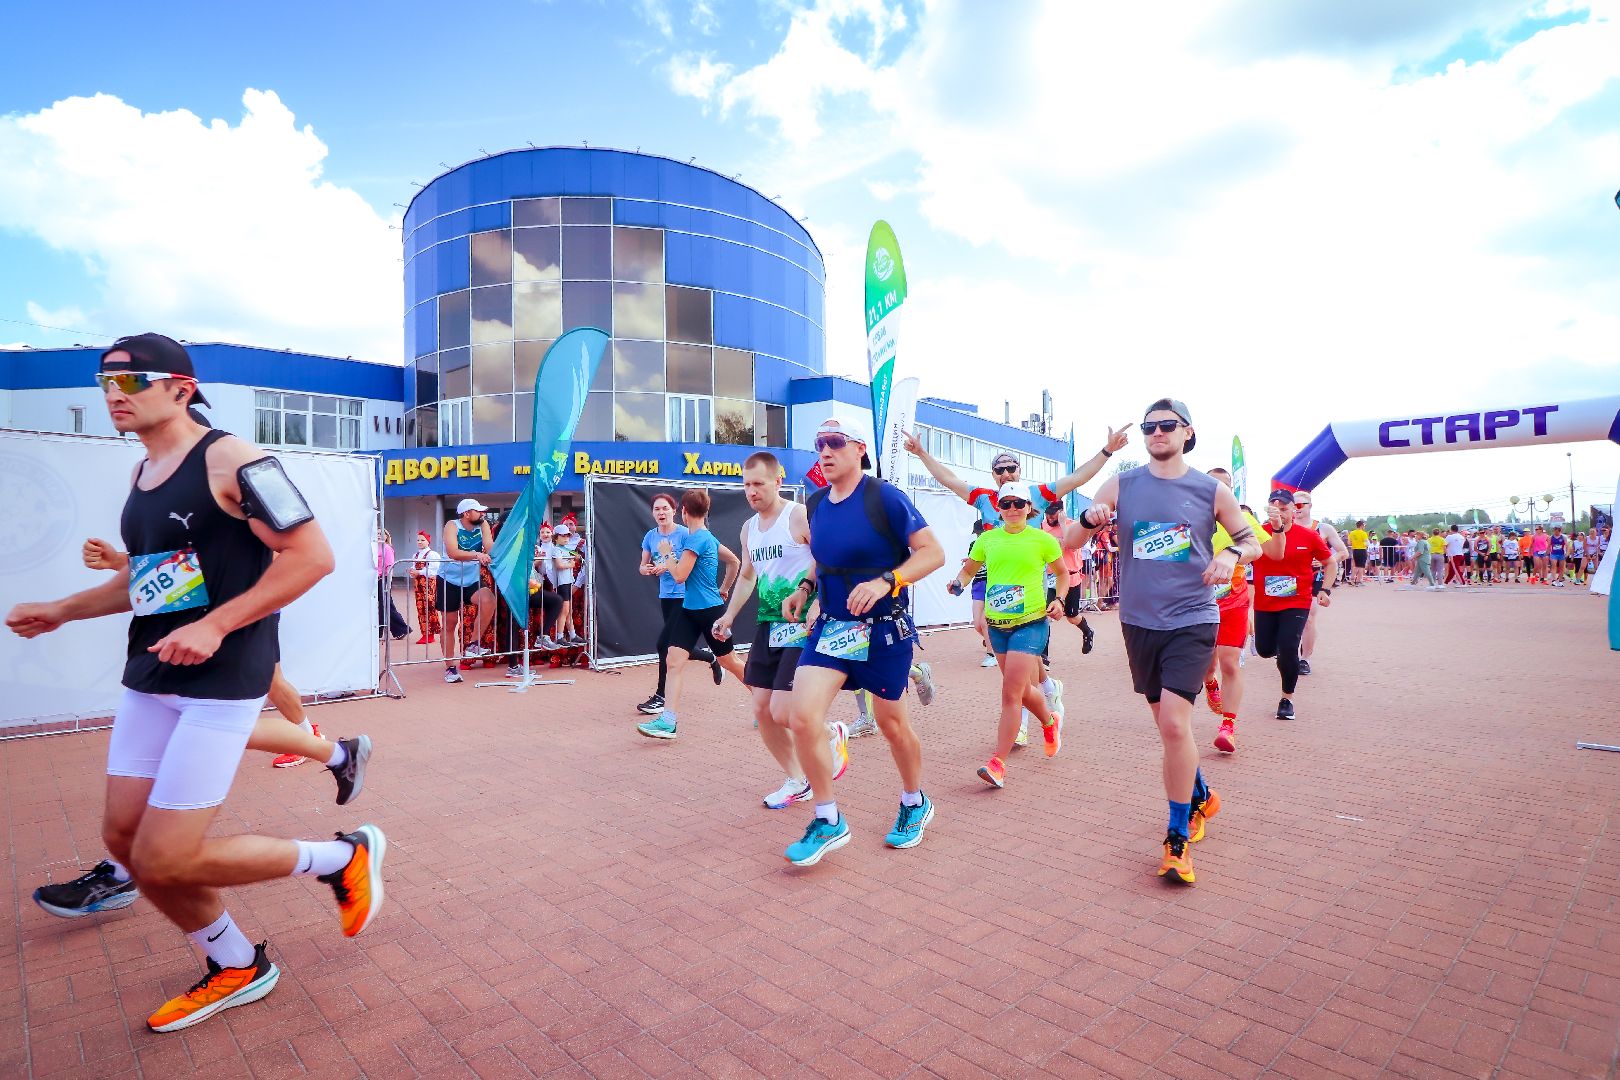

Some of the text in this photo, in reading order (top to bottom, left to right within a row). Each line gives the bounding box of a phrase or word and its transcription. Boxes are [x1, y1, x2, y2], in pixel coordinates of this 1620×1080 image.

[1378, 404, 1559, 448] СТАРТ
[384, 454, 490, 485] ДВОРЕЦ
[1144, 534, 1175, 554] 259
[139, 572, 175, 603] 318
[776, 625, 796, 643] 278
[829, 632, 857, 652] 254
